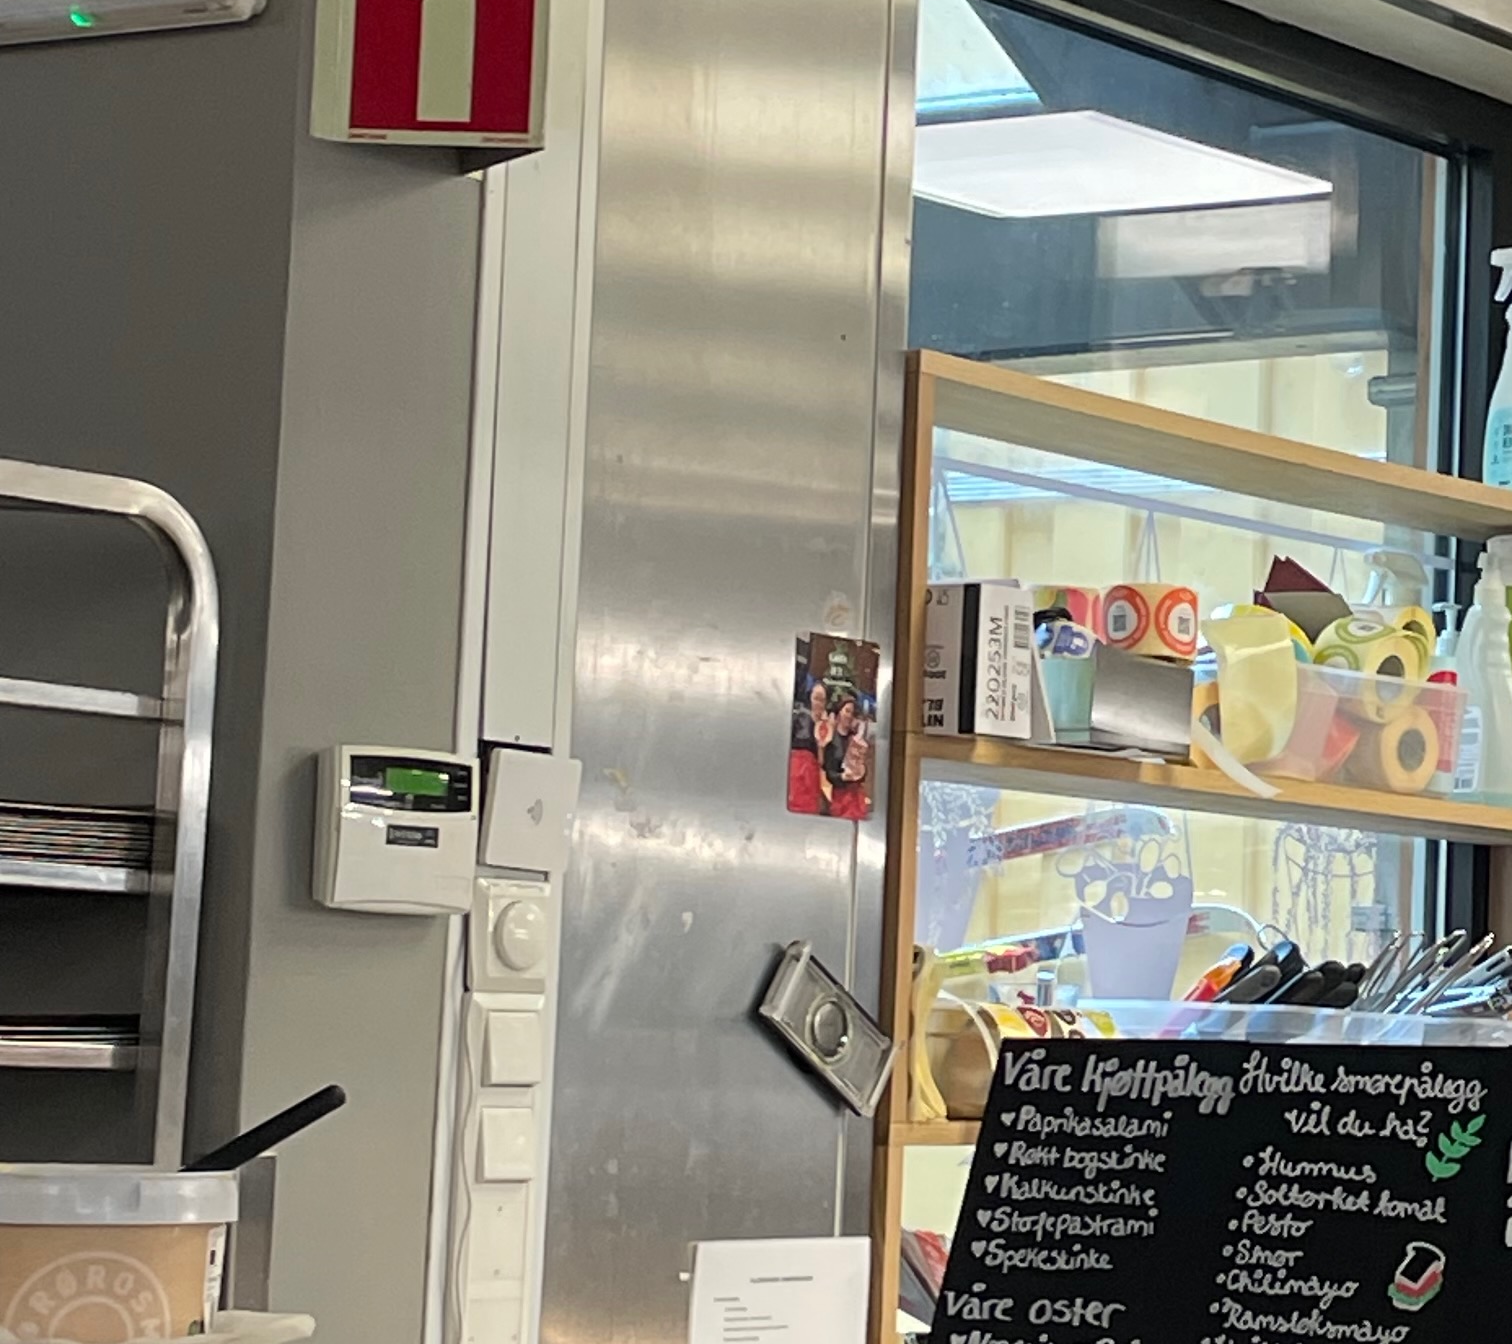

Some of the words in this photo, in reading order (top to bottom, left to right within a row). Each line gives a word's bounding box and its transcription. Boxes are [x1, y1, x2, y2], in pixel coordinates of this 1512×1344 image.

[1003, 1048, 1074, 1092] Våre
[1239, 1050, 1327, 1094] Hvilke
[1016, 1106, 1173, 1139] Paprikasalami
[1337, 1109, 1375, 1136] du
[1379, 1110, 1433, 1148] ha?
[1258, 1146, 1377, 1183] Hummus
[1241, 1209, 1314, 1238] Pesto
[944, 1282, 1014, 1322] Våre
[1029, 1297, 1127, 1329] oster
[1226, 1268, 1360, 1309] Chilimayo
